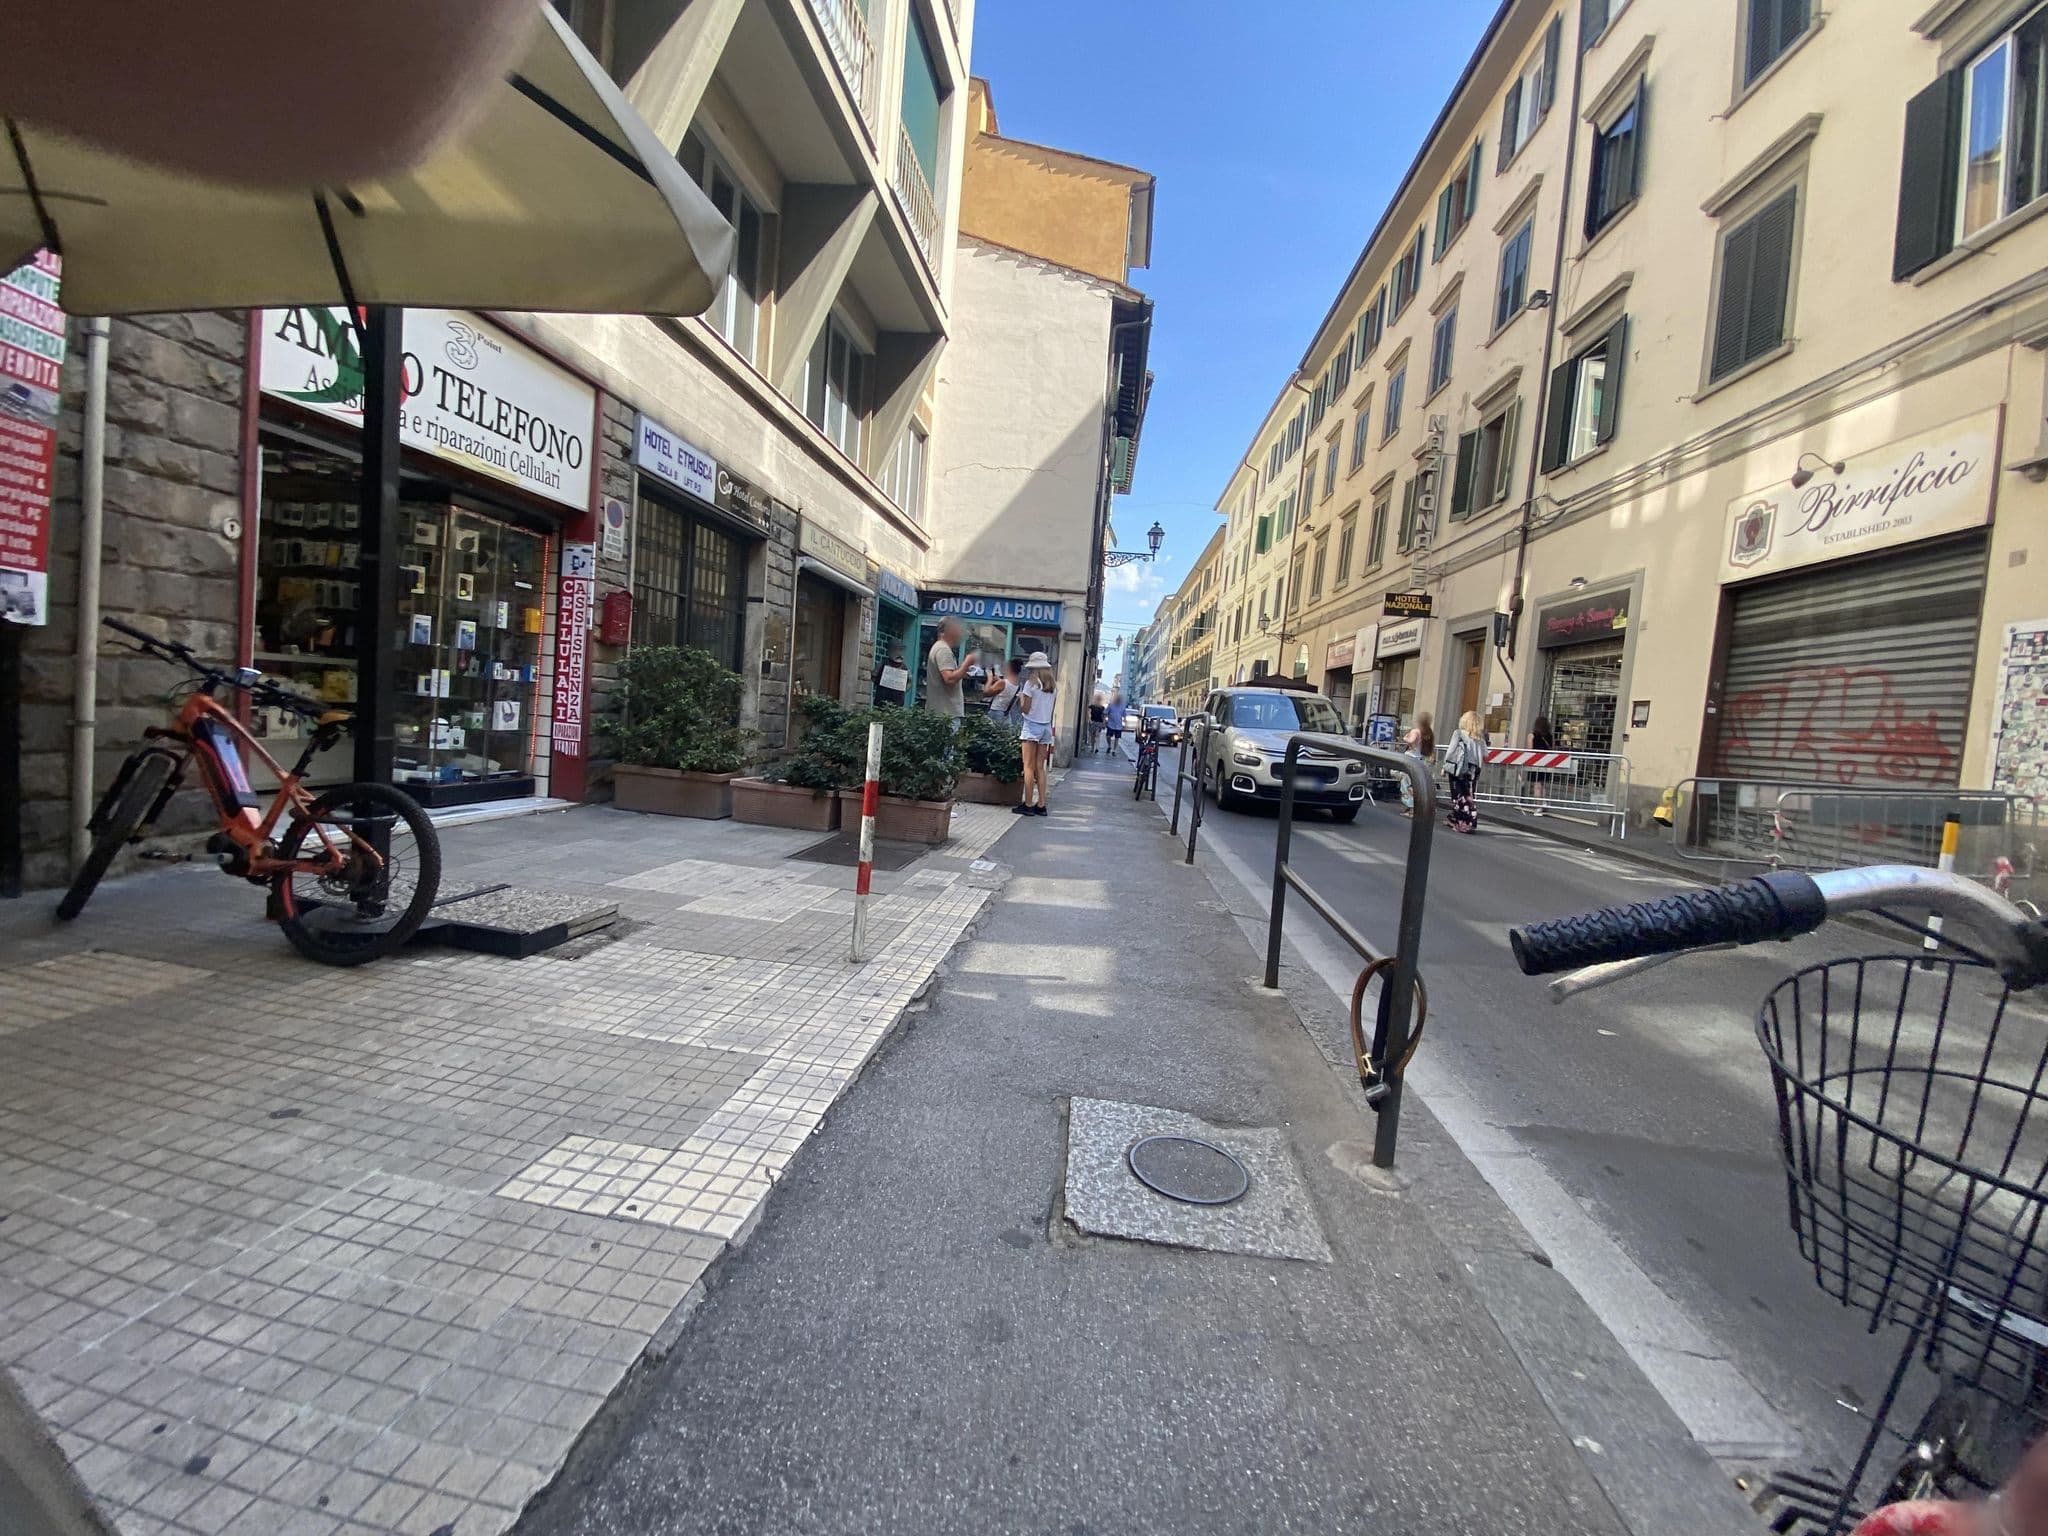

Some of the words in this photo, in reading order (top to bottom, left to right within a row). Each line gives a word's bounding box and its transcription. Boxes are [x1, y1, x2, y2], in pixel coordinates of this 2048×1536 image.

[433, 365, 582, 469] TELEFONO
[412, 418, 422, 434] e
[426, 416, 506, 468] riparazioni
[510, 450, 561, 489] Cellulari
[644, 426, 673, 460] HOTEL
[677, 447, 713, 483] ETRUSCA
[1784, 450, 1979, 537] Birrificio
[1823, 519, 1891, 545] ESTABLISHED
[991, 601, 1056, 621] ALBION
[1385, 601, 1431, 610] NAZIONALE
[1395, 595, 1422, 604] HOTEL
[556, 580, 574, 719] CELLULARI
[568, 582, 586, 721] ASSISTENZA
